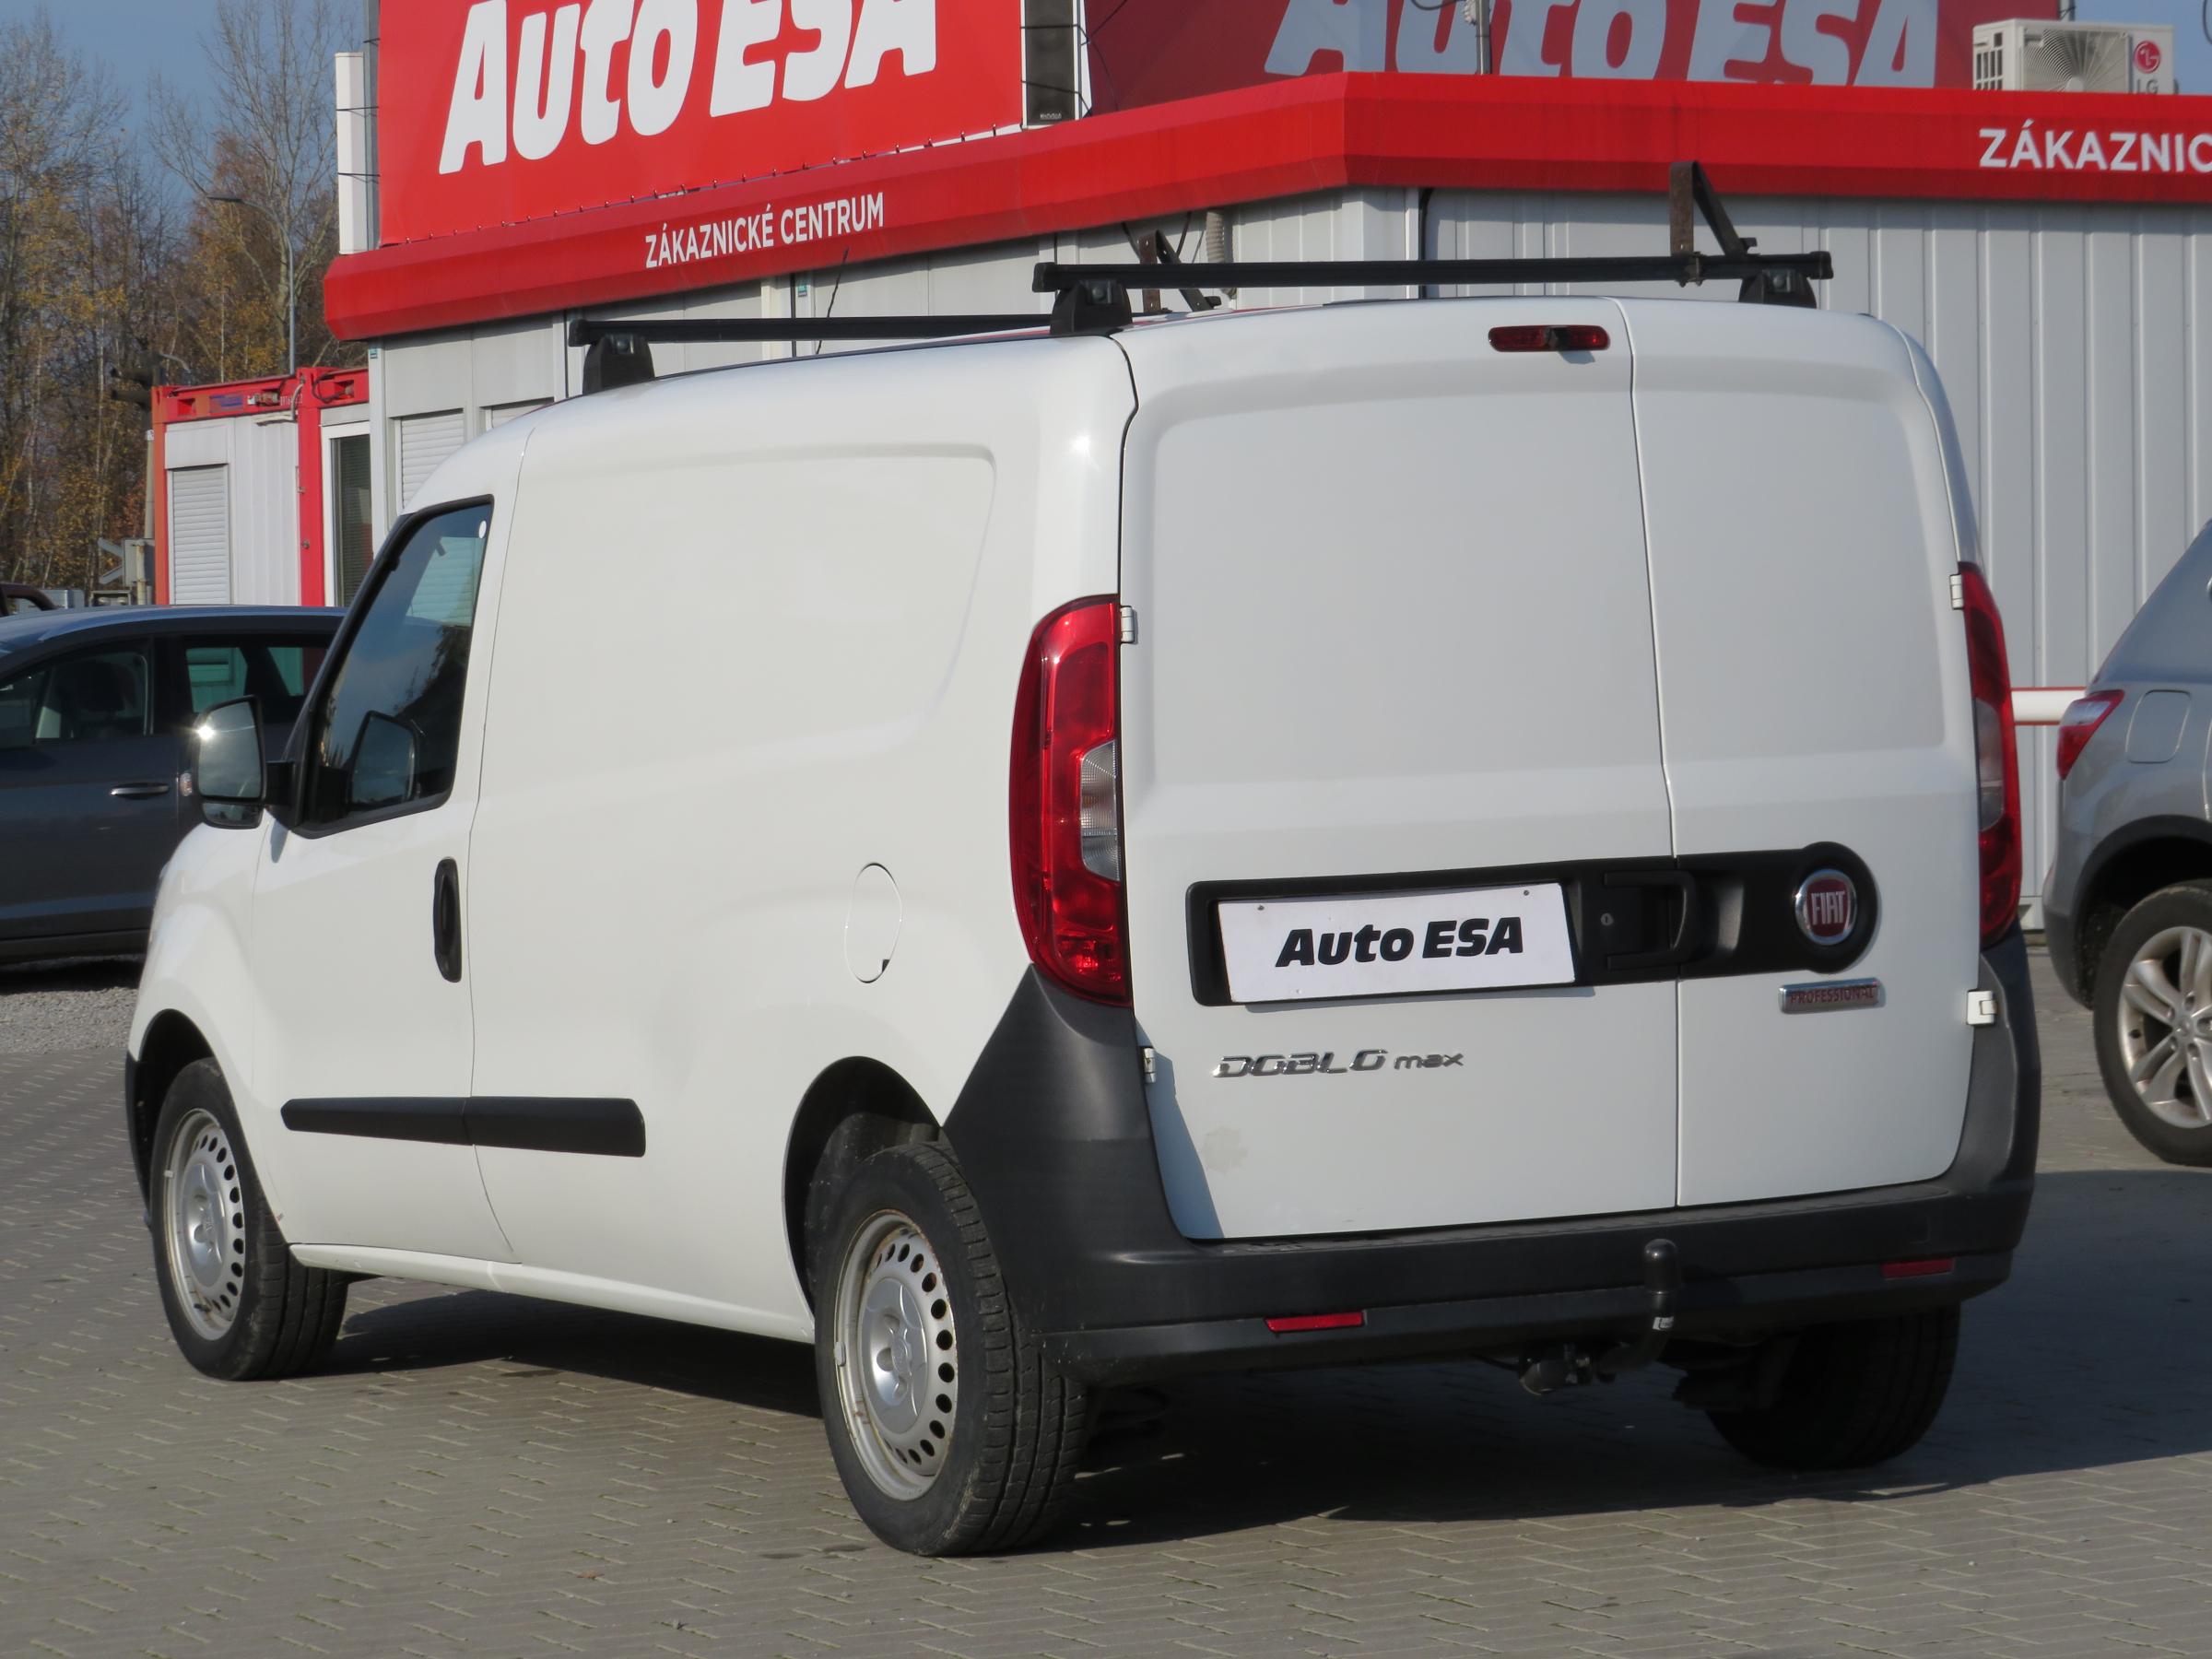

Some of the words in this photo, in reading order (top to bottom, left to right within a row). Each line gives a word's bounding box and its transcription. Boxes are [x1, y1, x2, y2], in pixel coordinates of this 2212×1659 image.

[1979, 118, 2212, 173] ZÁKAZNIC
[645, 203, 774, 268] ZÁKAZNICKÉ
[780, 192, 884, 245] CENTRUM
[1811, 891, 1845, 925] FIAT
[1275, 924, 1415, 968] Auto
[1421, 916, 1524, 959] ESA
[1791, 985, 1874, 1004] PROFESSIONAL
[1393, 1052, 1465, 1070] max
